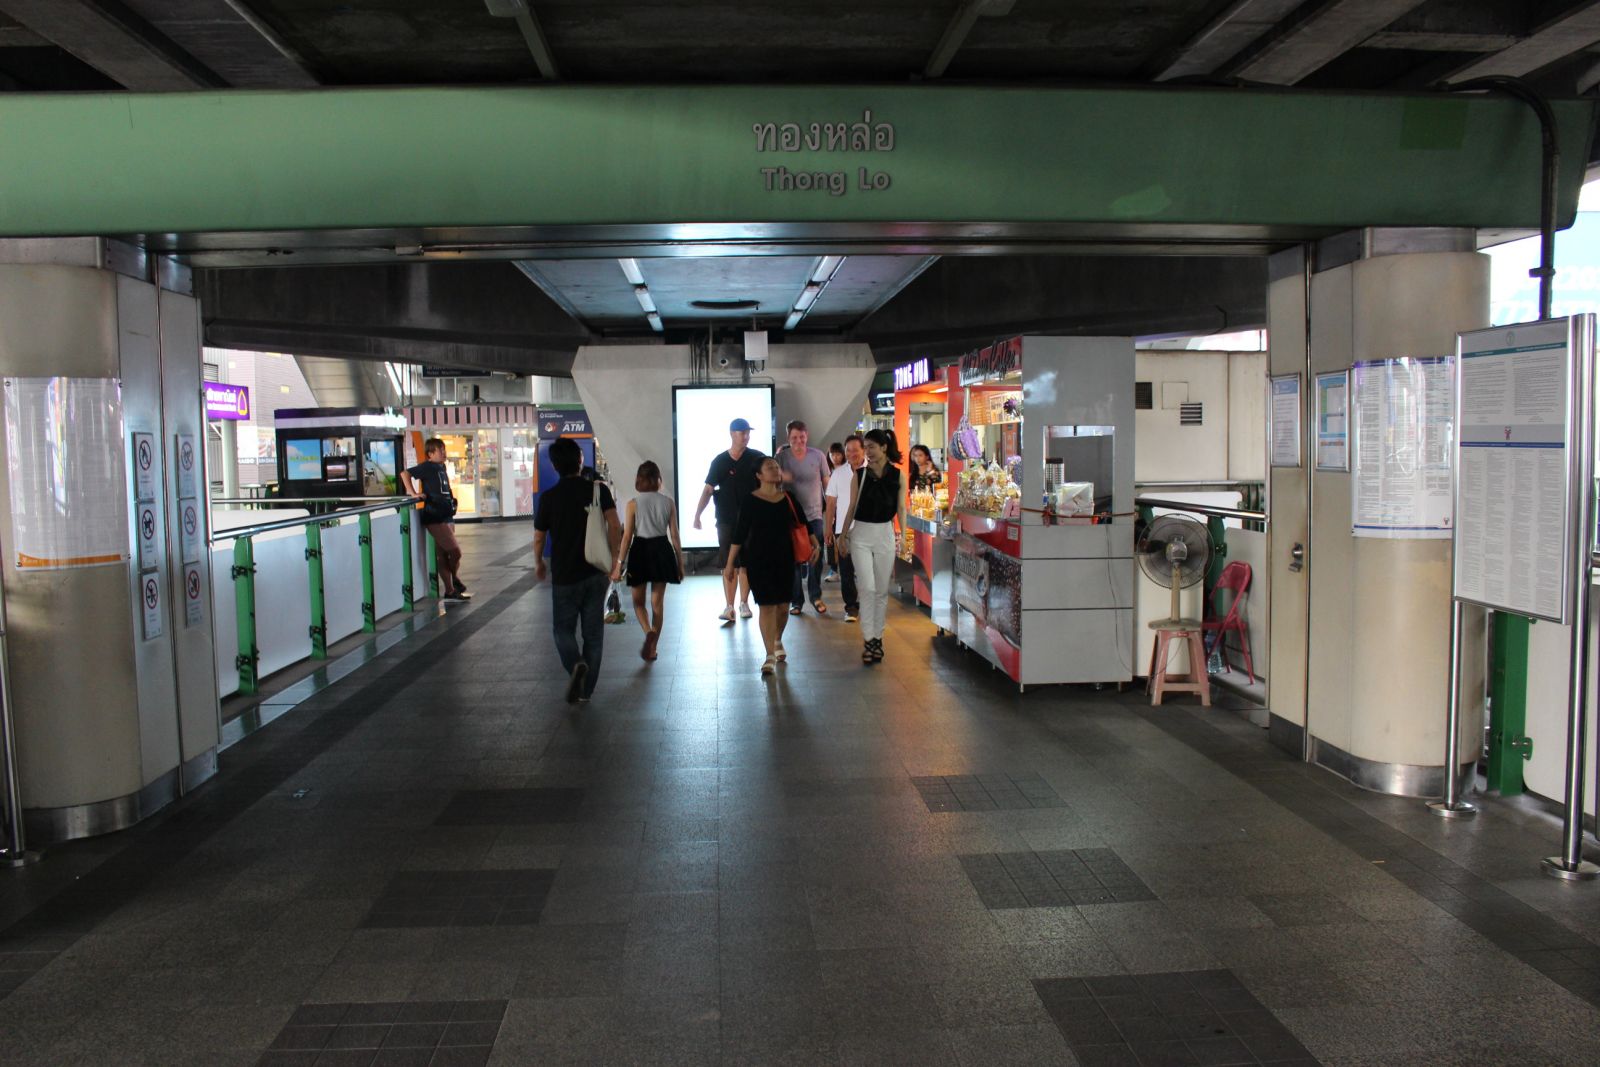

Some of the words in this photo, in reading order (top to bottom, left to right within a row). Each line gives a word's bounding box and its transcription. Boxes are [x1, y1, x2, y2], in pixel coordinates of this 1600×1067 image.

[752, 110, 895, 151] ทองหล่อ
[761, 166, 846, 196] Thong
[858, 167, 891, 190] Lo
[894, 363, 913, 390] TONG
[913, 357, 929, 385] HUA
[562, 423, 586, 432] ATM
